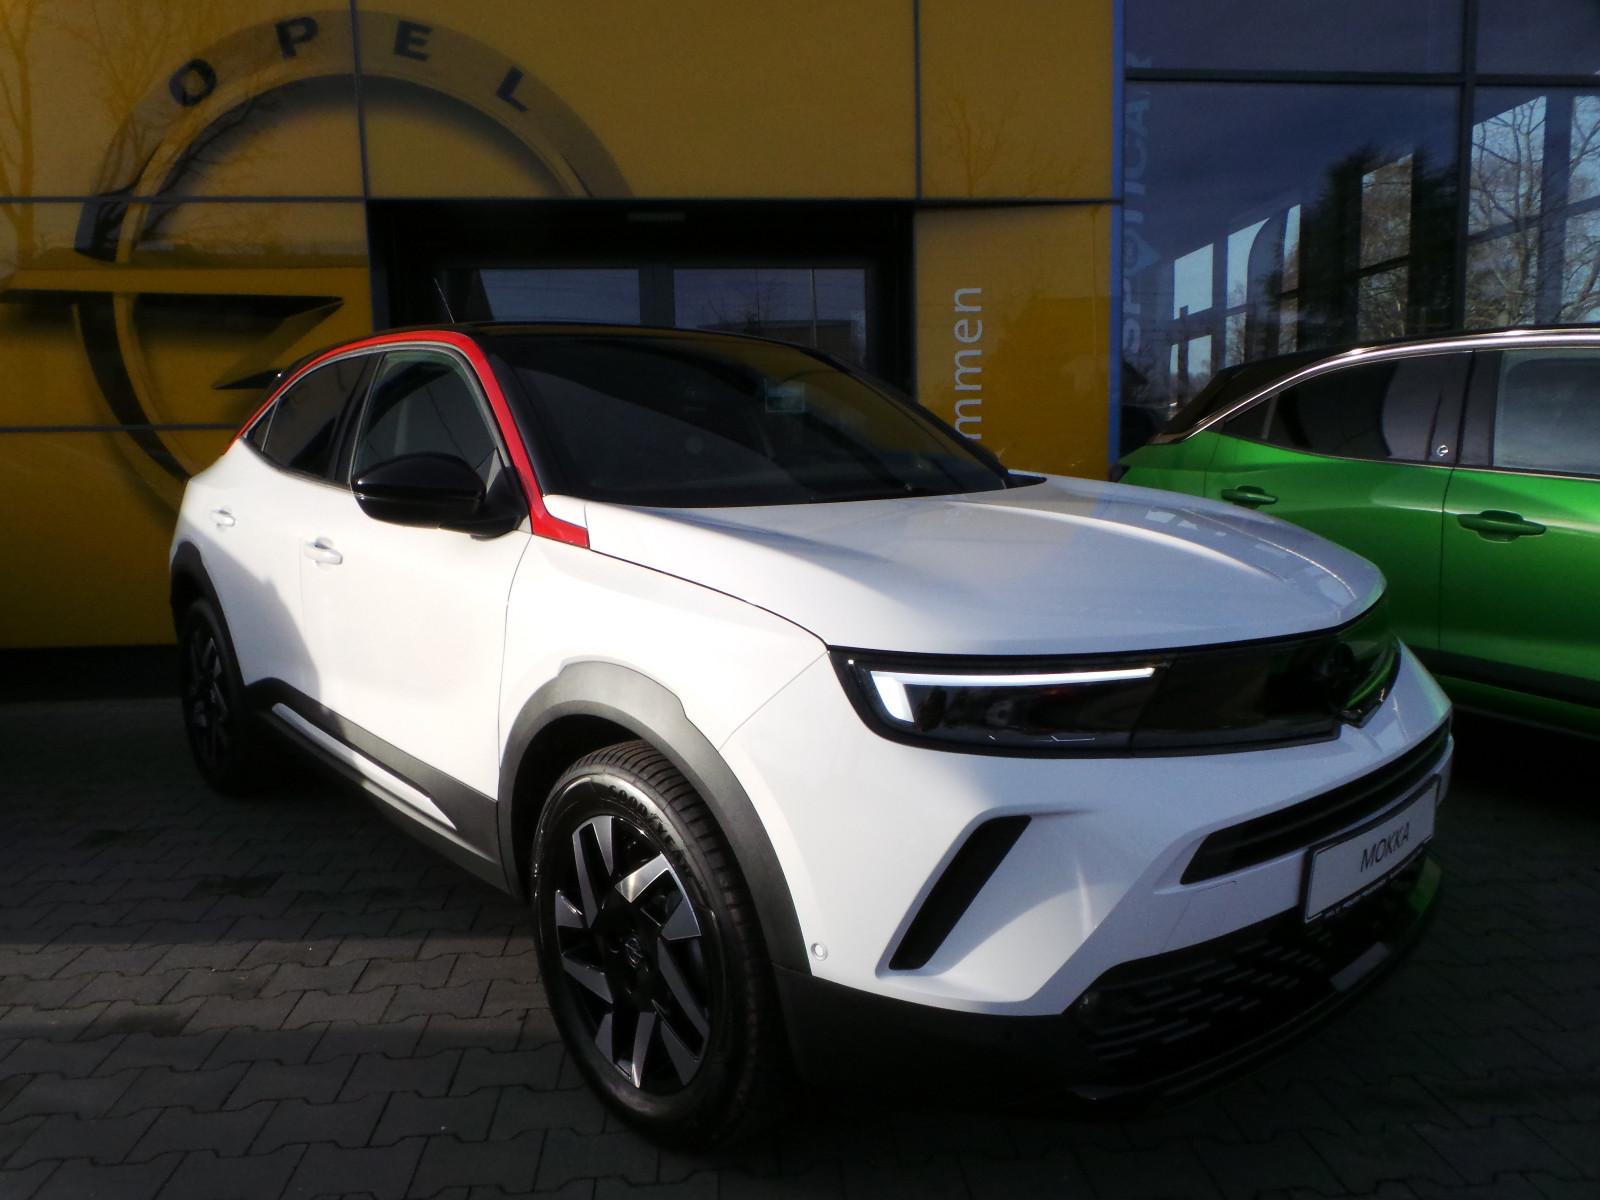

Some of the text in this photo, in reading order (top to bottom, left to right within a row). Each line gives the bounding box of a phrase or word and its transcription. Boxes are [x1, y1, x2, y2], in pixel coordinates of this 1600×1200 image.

[169, 16, 528, 112] OPEL
[953, 286, 983, 440] mmen
[1360, 821, 1410, 873] MOKKA
